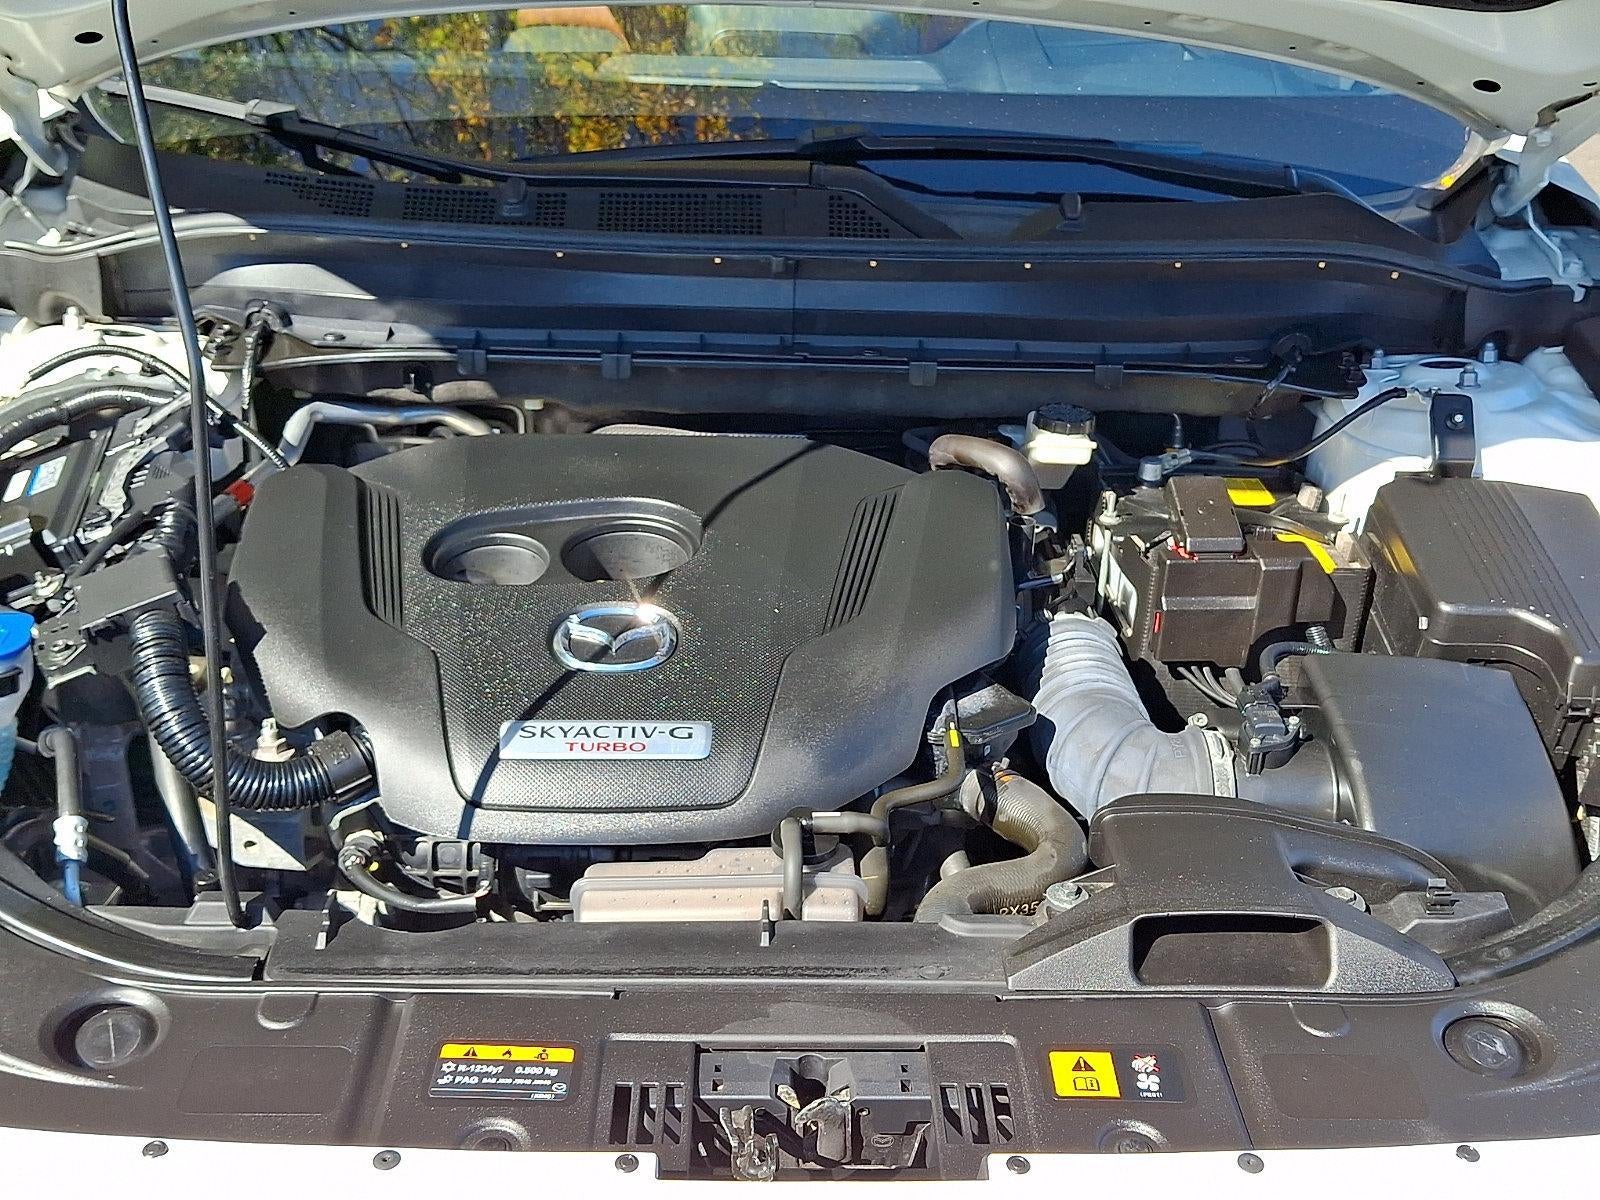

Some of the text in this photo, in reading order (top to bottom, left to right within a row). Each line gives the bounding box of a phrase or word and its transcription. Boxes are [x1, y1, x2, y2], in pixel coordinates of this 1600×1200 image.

[519, 725, 694, 740] SKYACTIV-G
[565, 741, 647, 752] TURBO
[544, 1066, 558, 1077] kg
[454, 1075, 479, 1085] PAG
